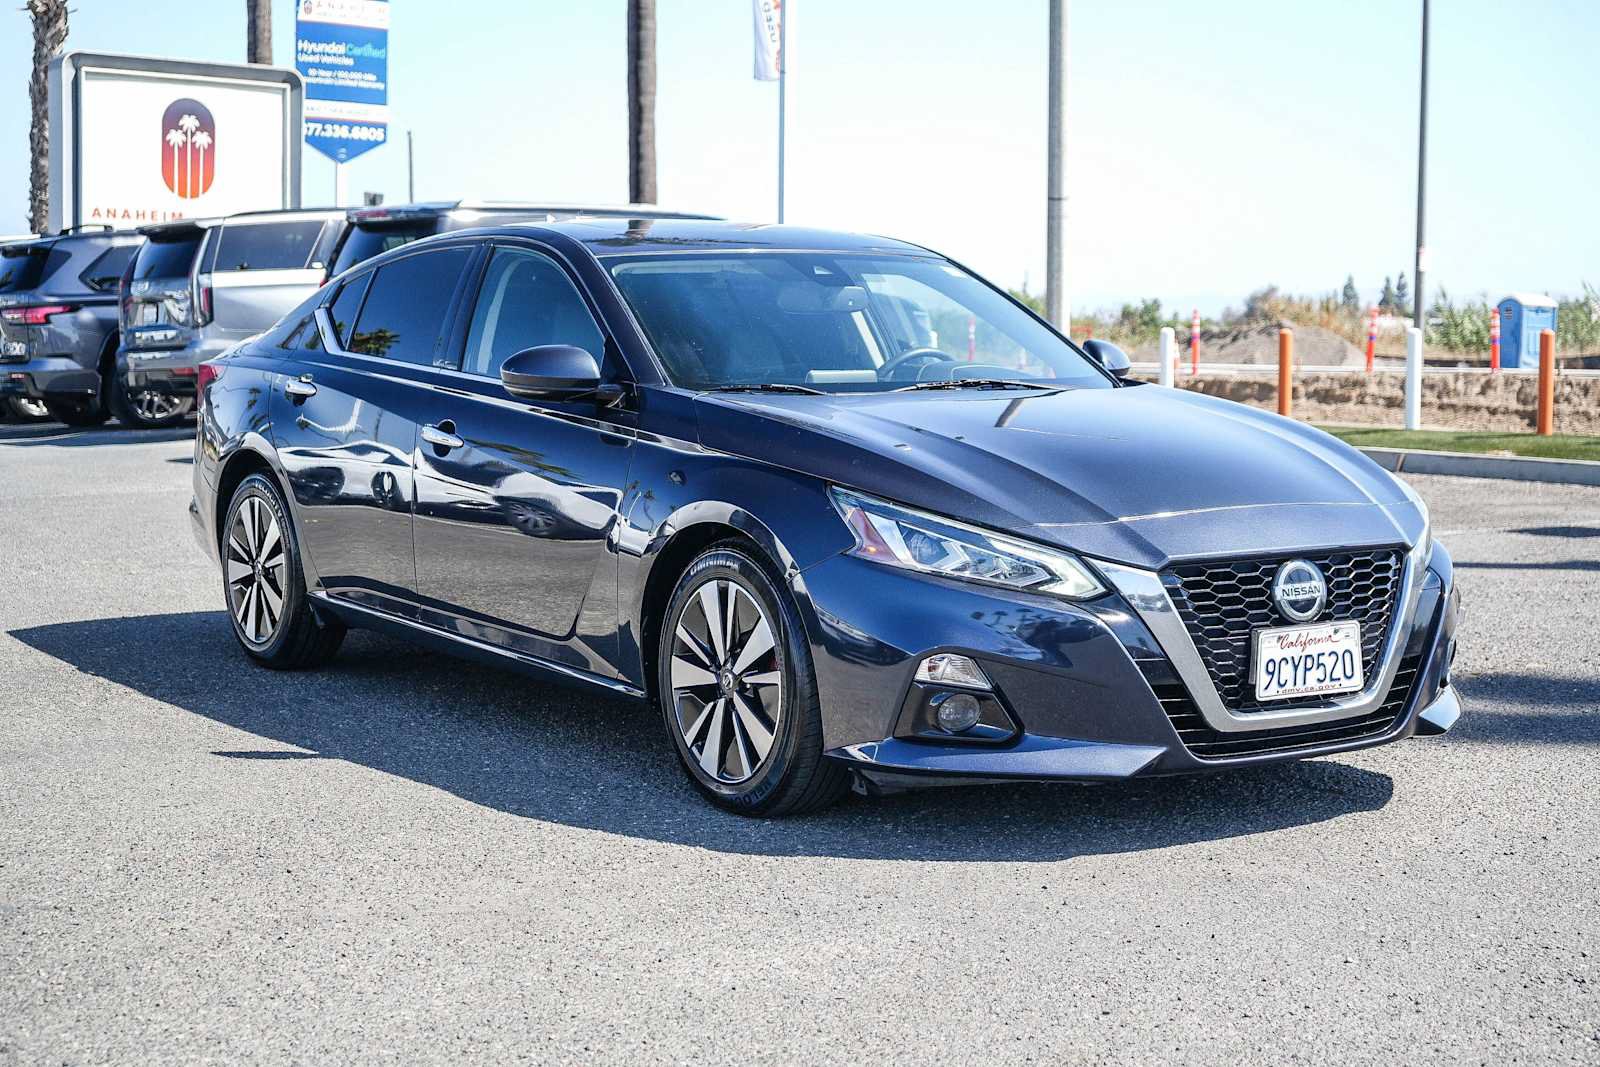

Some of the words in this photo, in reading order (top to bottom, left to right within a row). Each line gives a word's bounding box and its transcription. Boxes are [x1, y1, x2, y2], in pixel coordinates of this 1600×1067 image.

[297, 39, 346, 54] Hyundai
[347, 42, 386, 58] Certified
[91, 207, 183, 223] ANAHEIM
[1281, 584, 1321, 598] NISSAN
[1279, 631, 1340, 652] California
[1263, 649, 1355, 691] 9CYP520
